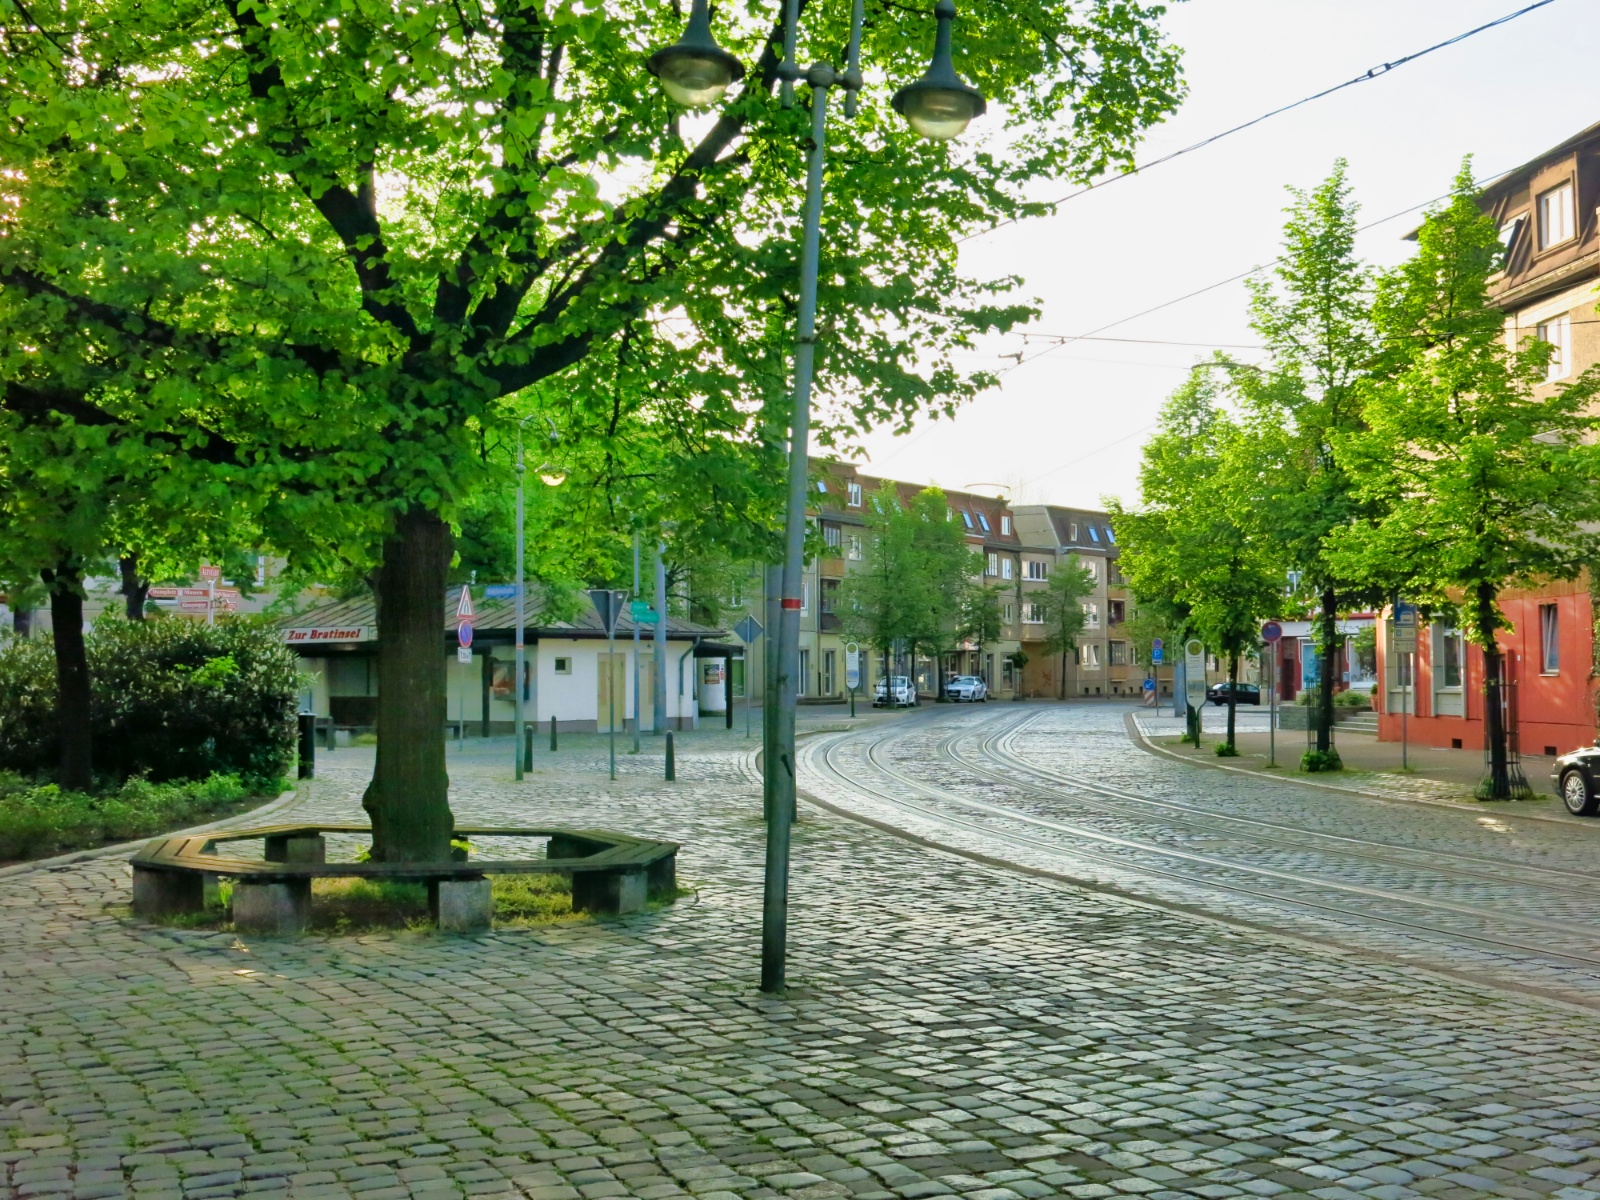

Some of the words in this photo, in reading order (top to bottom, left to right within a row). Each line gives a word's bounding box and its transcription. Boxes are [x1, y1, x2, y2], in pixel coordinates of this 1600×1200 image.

[287, 630, 307, 640] Zur
[309, 629, 361, 639] Bratinsel
[1154, 650, 1160, 658] P
